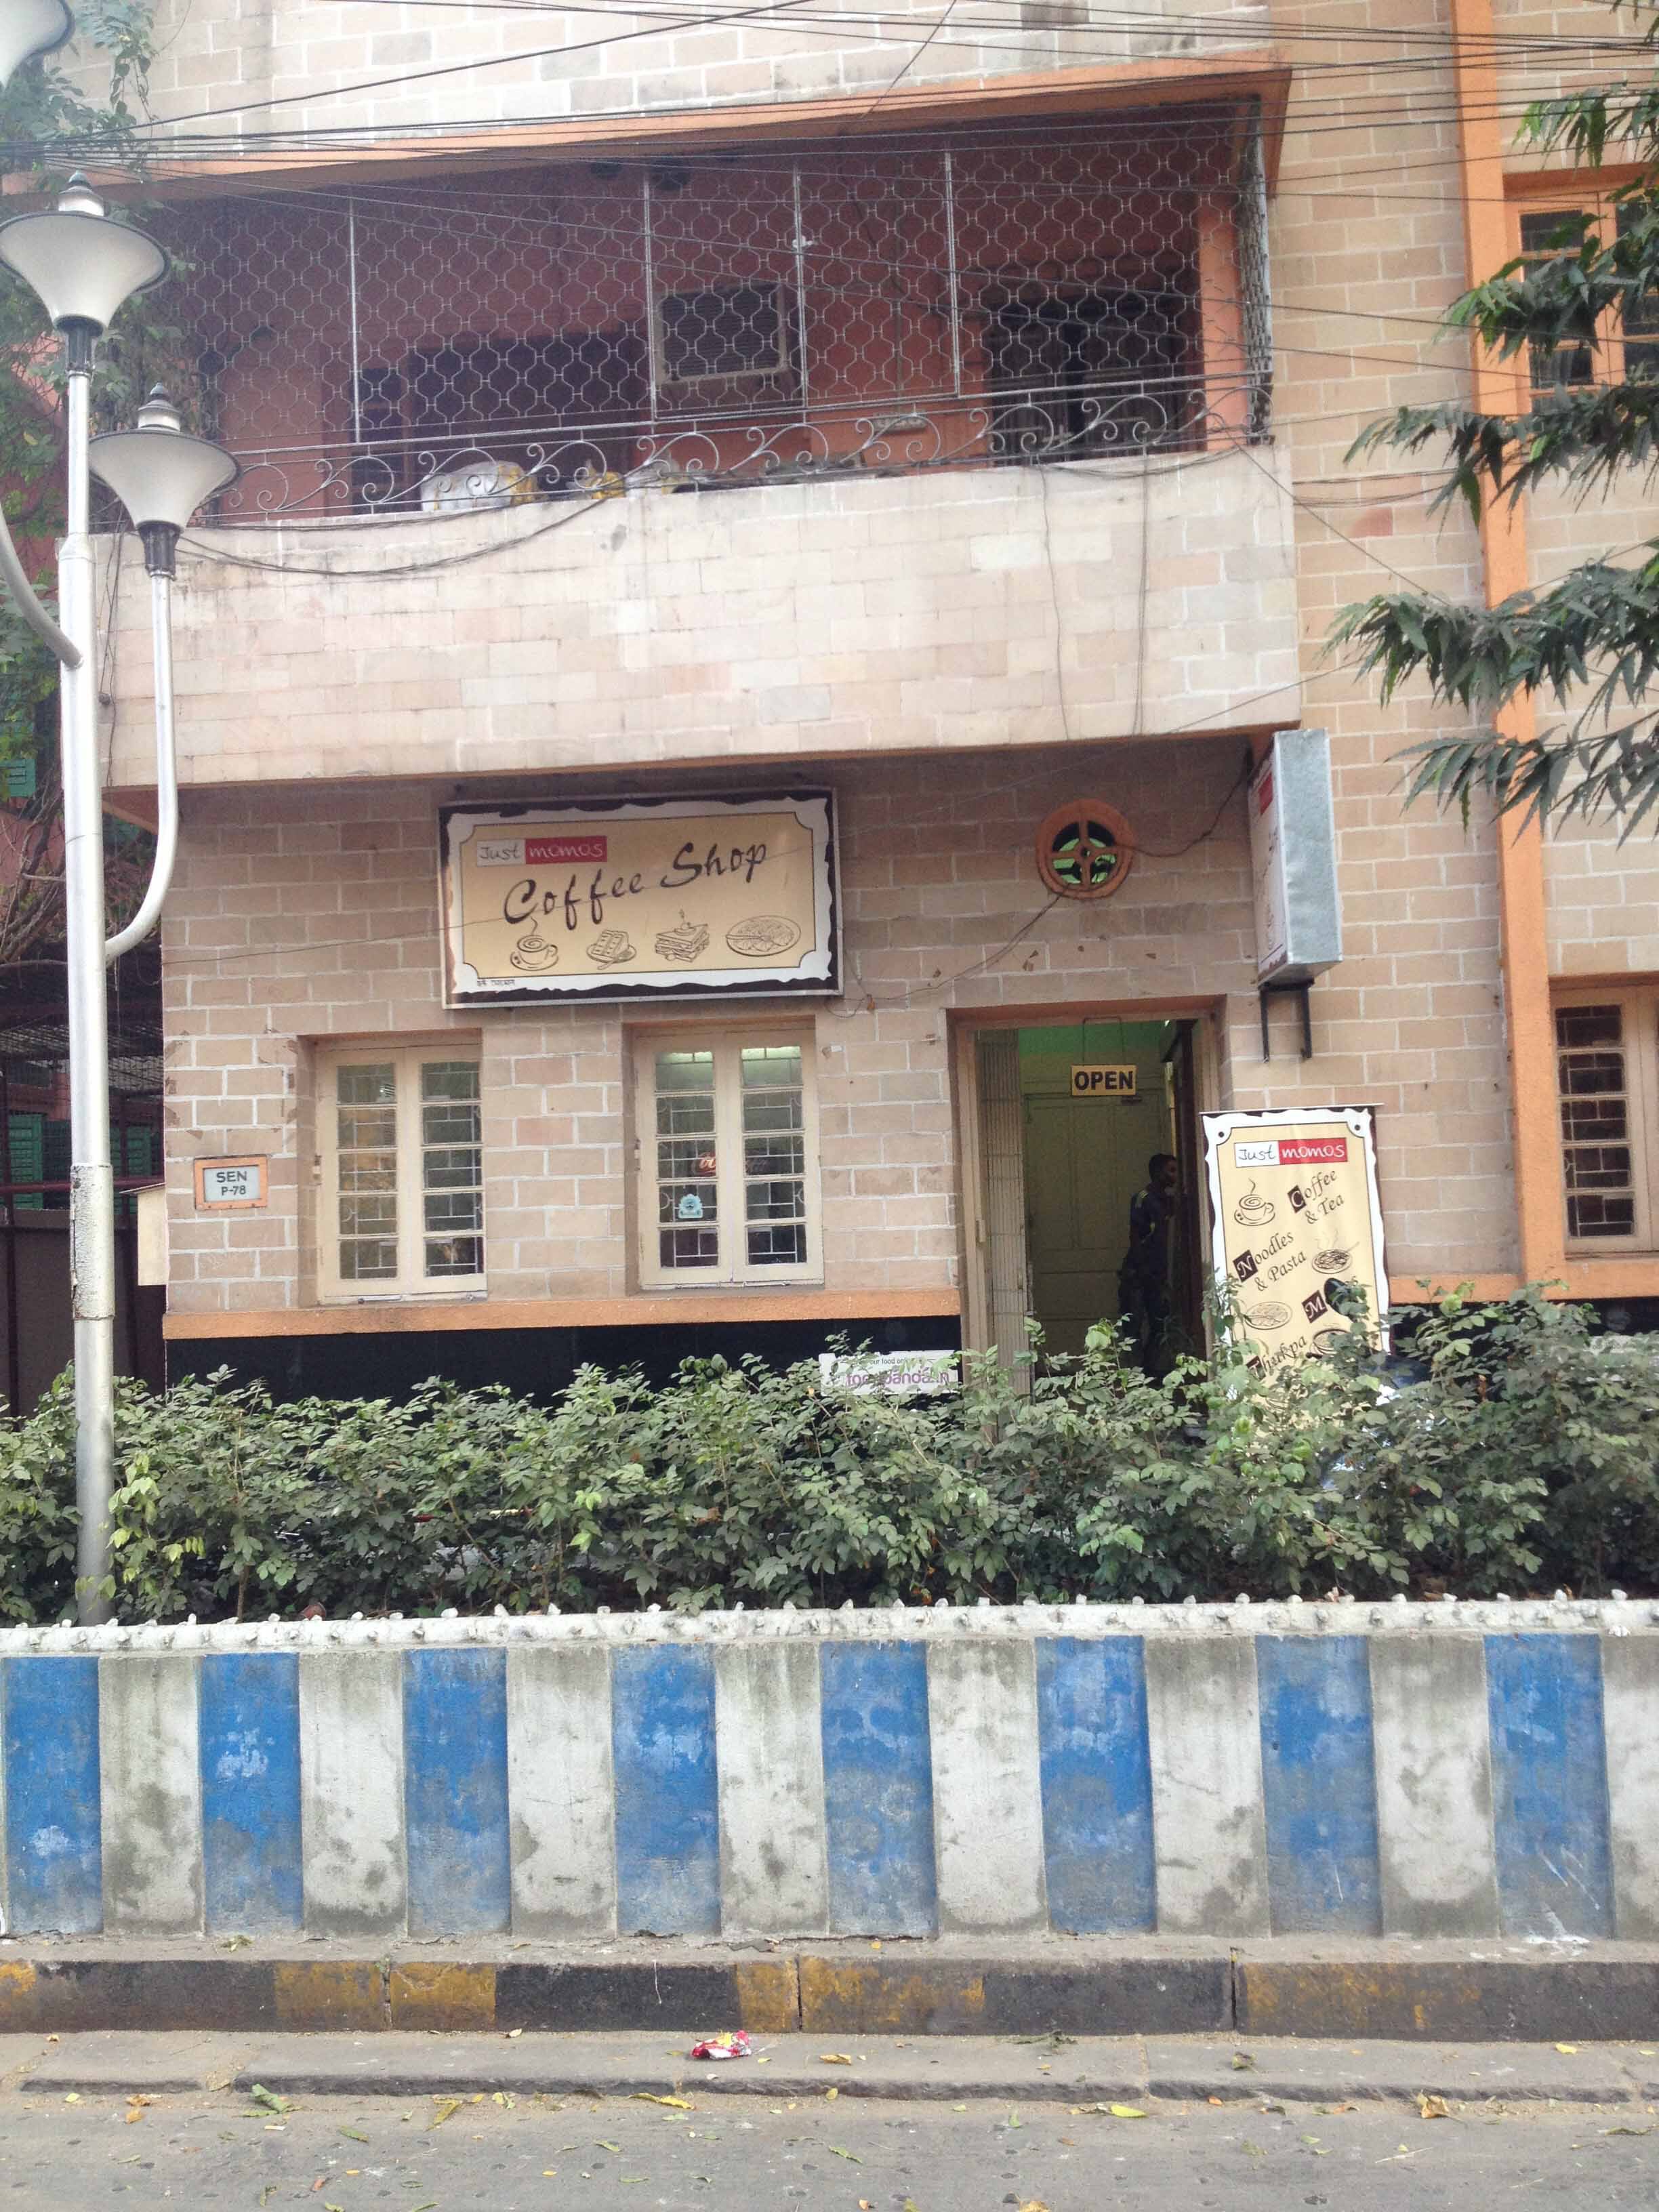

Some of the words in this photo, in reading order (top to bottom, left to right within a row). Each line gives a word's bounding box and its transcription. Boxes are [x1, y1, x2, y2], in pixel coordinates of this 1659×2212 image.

[479, 843, 521, 861] Just
[529, 843, 603, 859] momos
[504, 868, 644, 930] Coffee
[660, 841, 768, 888] Shop
[1074, 1070, 1134, 1090] OPEN
[1238, 1143, 1276, 1161] Just
[1281, 1144, 1345, 1159] momos
[216, 1170, 247, 1183] SEN
[221, 1185, 247, 1196] P-78
[1289, 1170, 1338, 1210] Coffee
[1307, 1209, 1318, 1225] &
[1319, 1193, 1345, 1217] Tea
[1235, 1231, 1295, 1279] Noodles
[1254, 1277, 1269, 1292] &
[1269, 1251, 1307, 1283] Pasta
